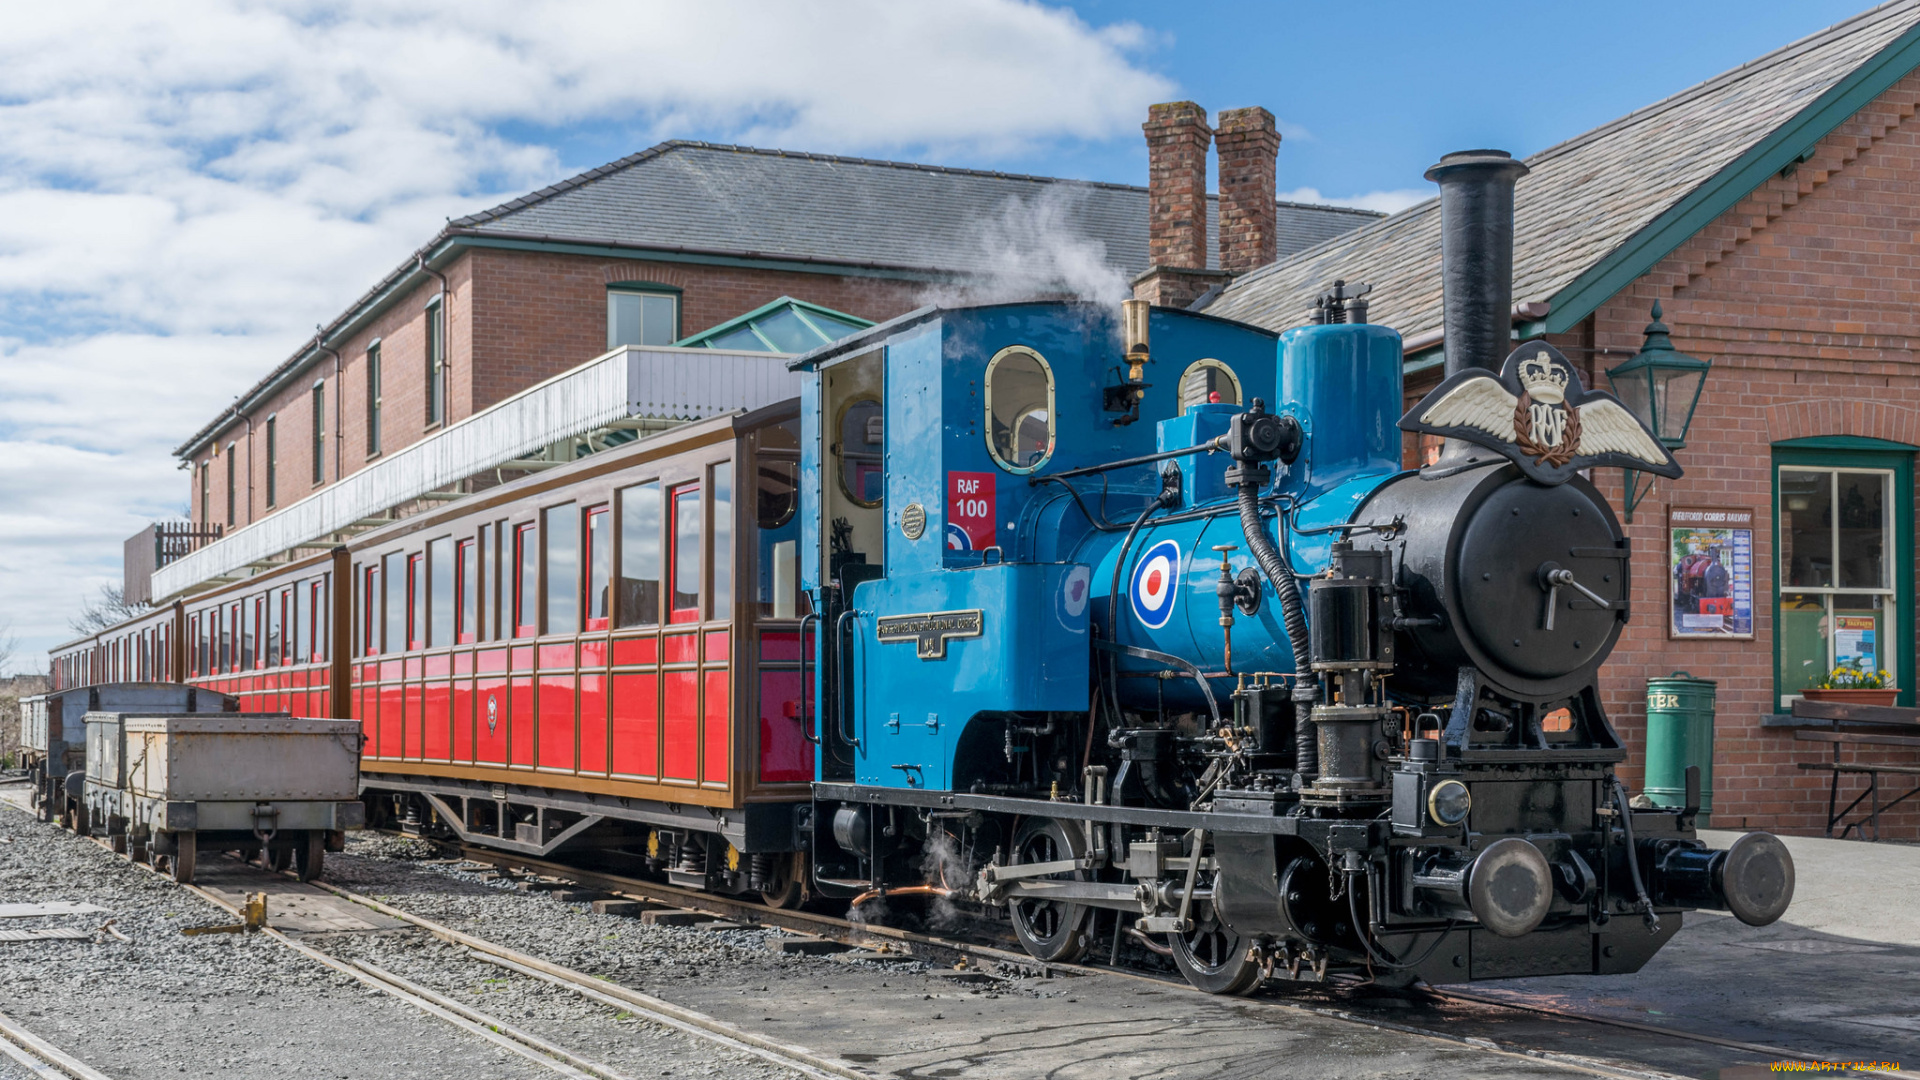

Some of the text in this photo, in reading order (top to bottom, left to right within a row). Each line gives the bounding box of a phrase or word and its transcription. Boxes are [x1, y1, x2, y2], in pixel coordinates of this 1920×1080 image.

[1528, 403, 1568, 447] RAF
[957, 479, 980, 494] RAF
[956, 498, 988, 518] 100
[1703, 512, 1726, 522] CORRIS
[1726, 513, 1751, 522] RAILWAY
[956, 616, 977, 629] CORPS
